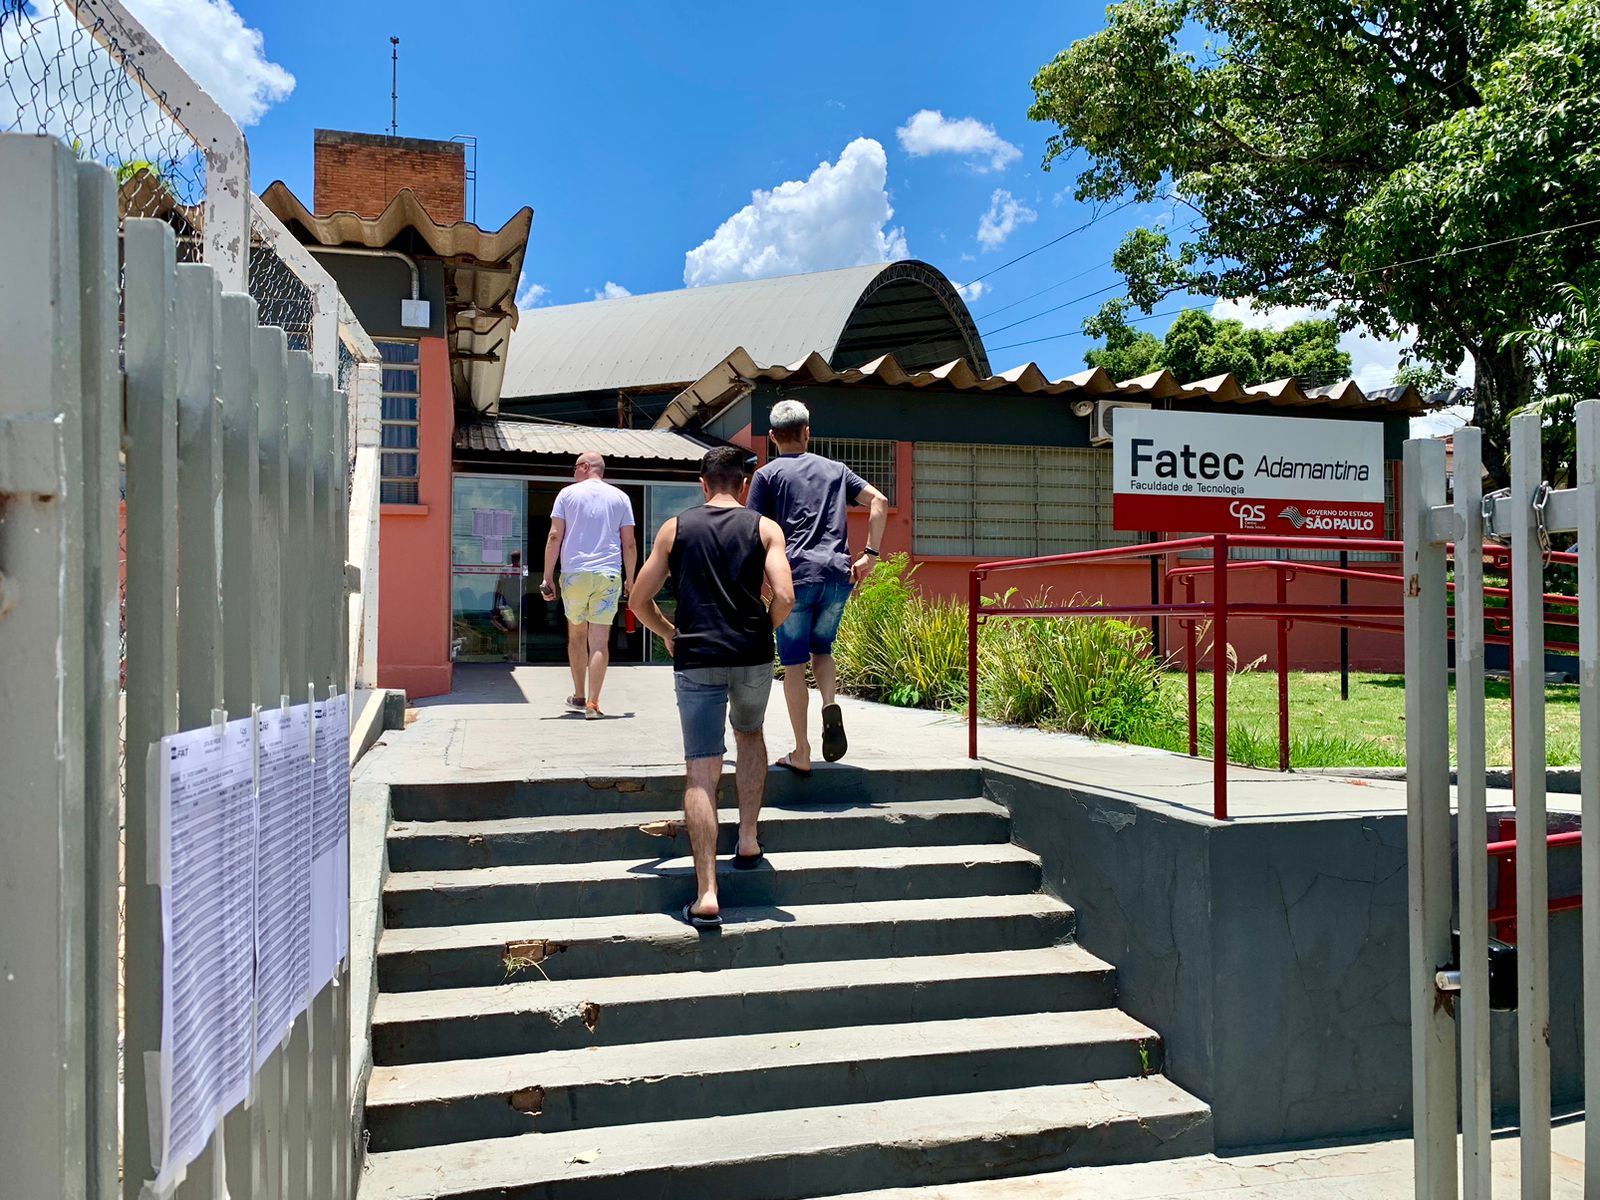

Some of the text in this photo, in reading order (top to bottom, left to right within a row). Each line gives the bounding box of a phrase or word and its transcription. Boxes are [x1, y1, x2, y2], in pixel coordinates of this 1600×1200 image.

[1131, 438, 1369, 481] Fatec Adamantina
[1130, 480, 1244, 496] Faculdade de Tecnologia
[1306, 508, 1338, 516] GOVERNO
[1305, 515, 1374, 531] SÃO PAULO
